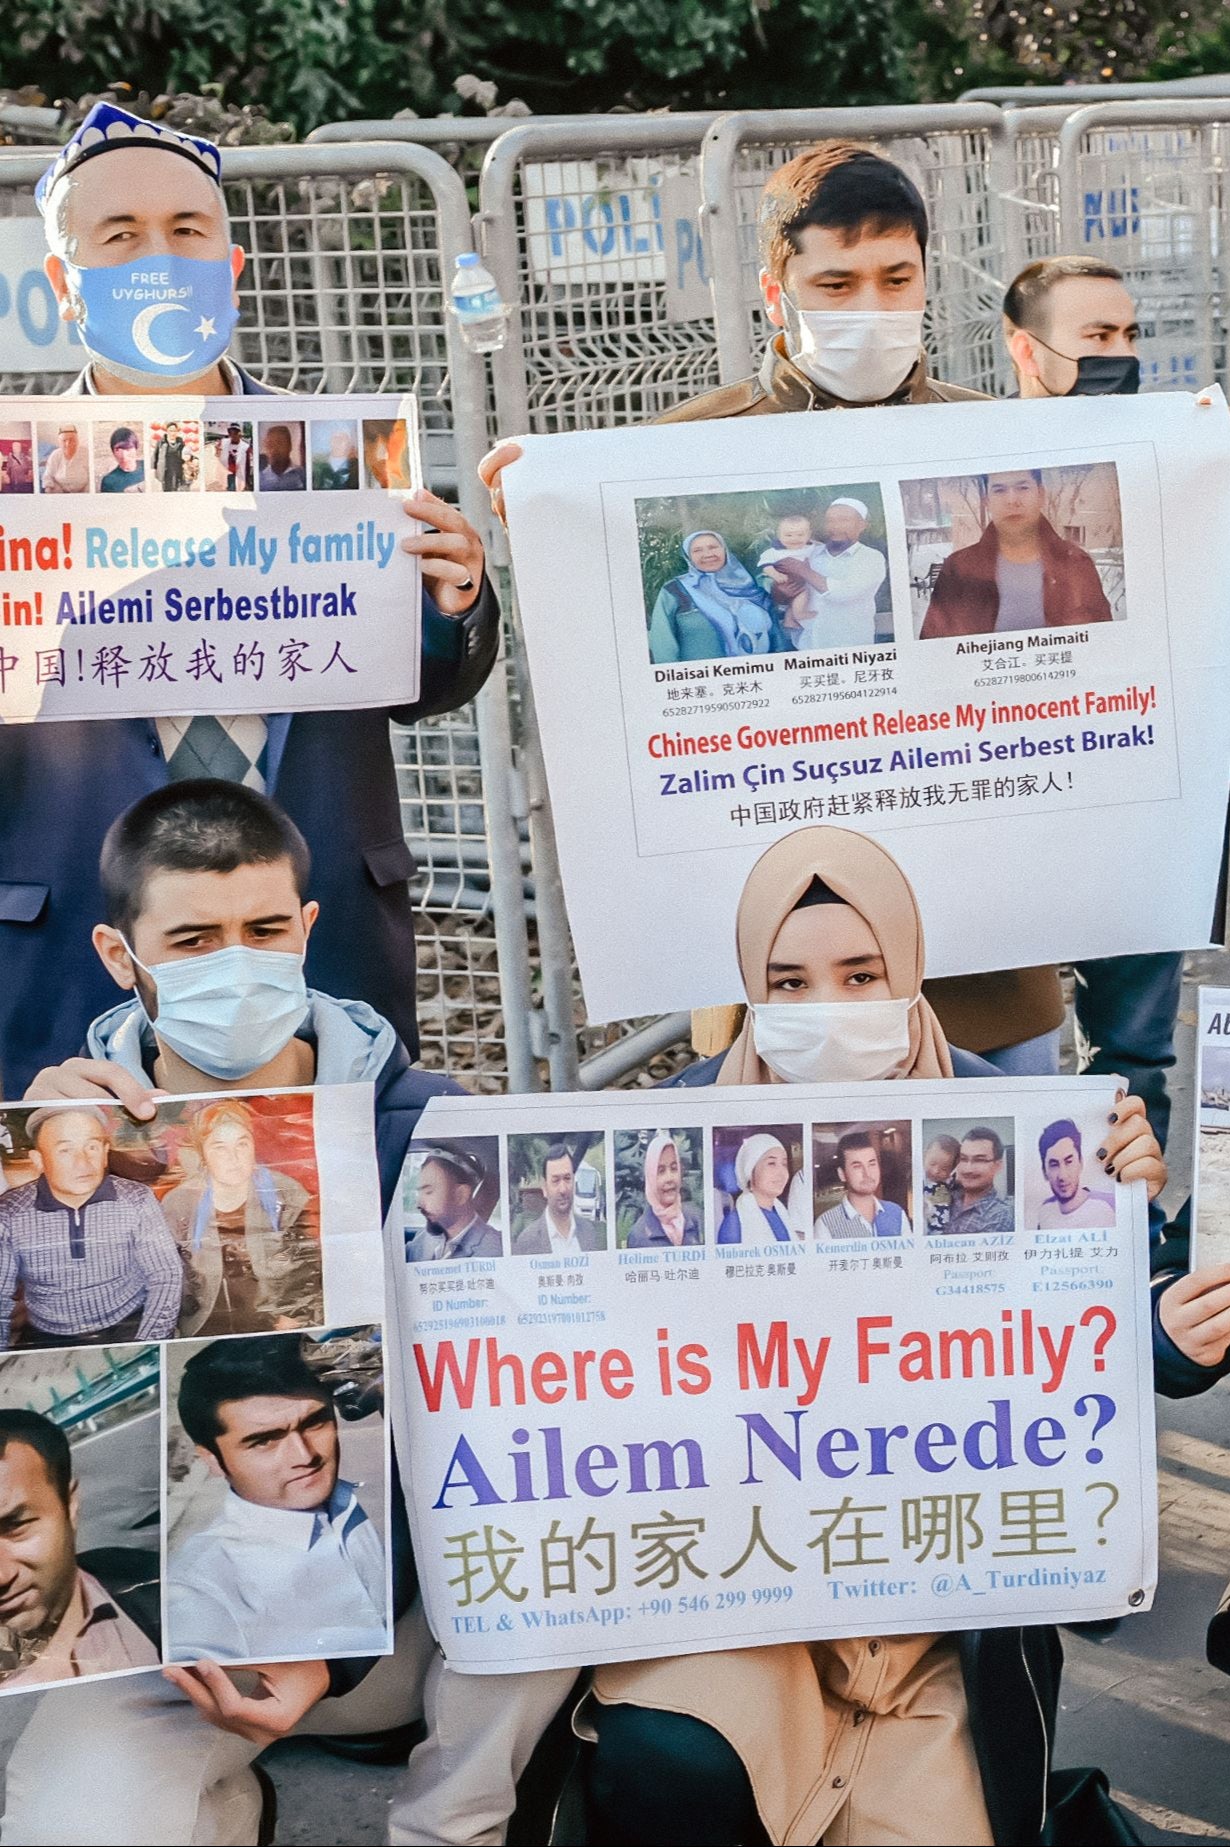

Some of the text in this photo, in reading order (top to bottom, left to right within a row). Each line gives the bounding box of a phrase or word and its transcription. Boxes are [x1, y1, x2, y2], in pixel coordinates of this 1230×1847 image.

[131, 272, 170, 285] FREE
[84, 527, 217, 569] Release
[228, 525, 278, 575] My
[288, 520, 396, 570] family
[56, 589, 153, 626] Ailemi
[164, 583, 358, 622] Serbestbırak
[783, 648, 897, 672] Maimaiti Niyazi
[956, 630, 1090, 656] Aihejiang Maimaiti
[655, 661, 775, 683] Dilaisai Kemimu
[973, 669, 1077, 688] 652827198006142919
[662, 698, 771, 718] 652827195905072922
[791, 686, 898, 706] 652827195604122914
[648, 685, 1157, 759] Chinese Government Release My innocent Family!
[660, 723, 1156, 797] Zalim Çin Suçsuz Ailemi Serbest Bırak!
[412, 1305, 1118, 1413] Where is My Family?
[431, 1393, 1118, 1511] Ailem Nerede?
[826, 1566, 1107, 1600] Twitter: @A_Turdiniyaz
[451, 1585, 795, 1634] TEL & WhatsApp: +90 546 299 9999
